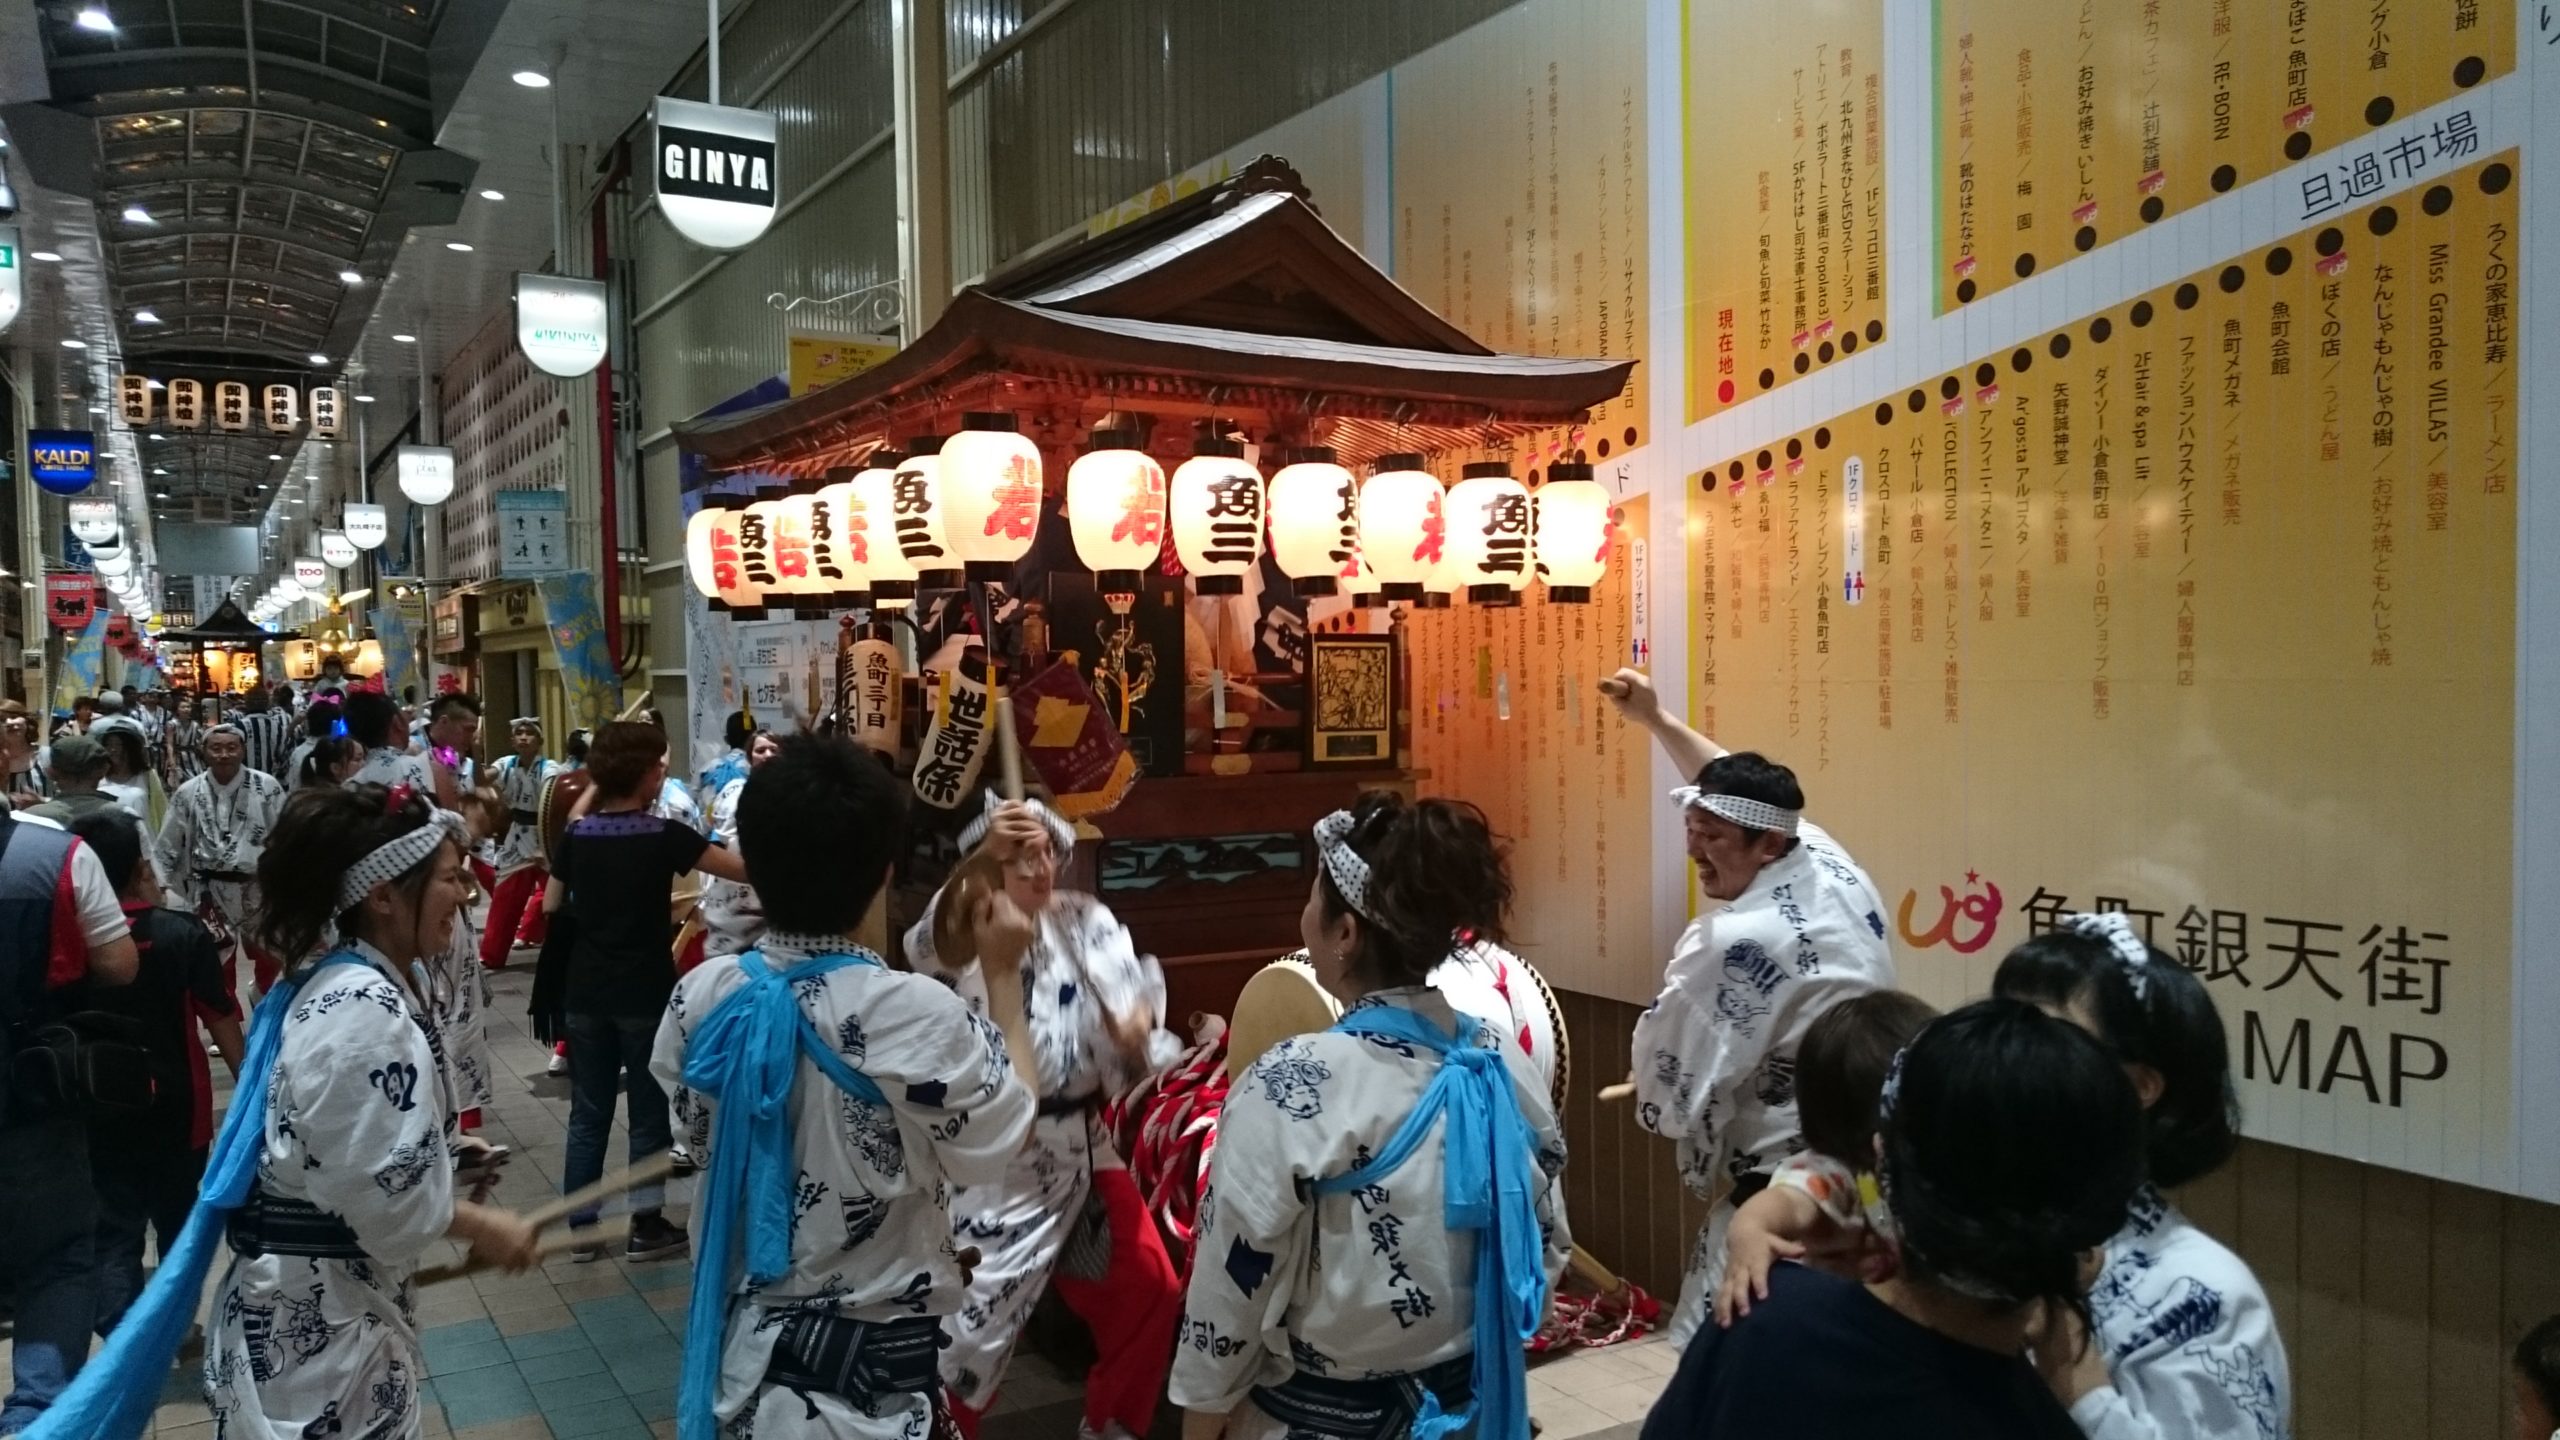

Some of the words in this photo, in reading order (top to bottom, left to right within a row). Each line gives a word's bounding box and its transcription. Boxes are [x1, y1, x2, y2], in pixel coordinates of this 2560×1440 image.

[665, 144, 769, 191] GINYA
[2301, 111, 2481, 220] 旦過市場
[2429, 243, 2448, 284] Miss
[1718, 309, 1734, 375] 現在地
[2270, 301, 2291, 376] 魚町会館
[2428, 293, 2449, 371] Grandee
[34, 449, 90, 465] KALDI
[298, 568, 323, 577] ZOO
[865, 651, 890, 729] 魚町三丁目
[917, 686, 987, 803] 世話係
[2243, 1010, 2449, 1107] MAP
